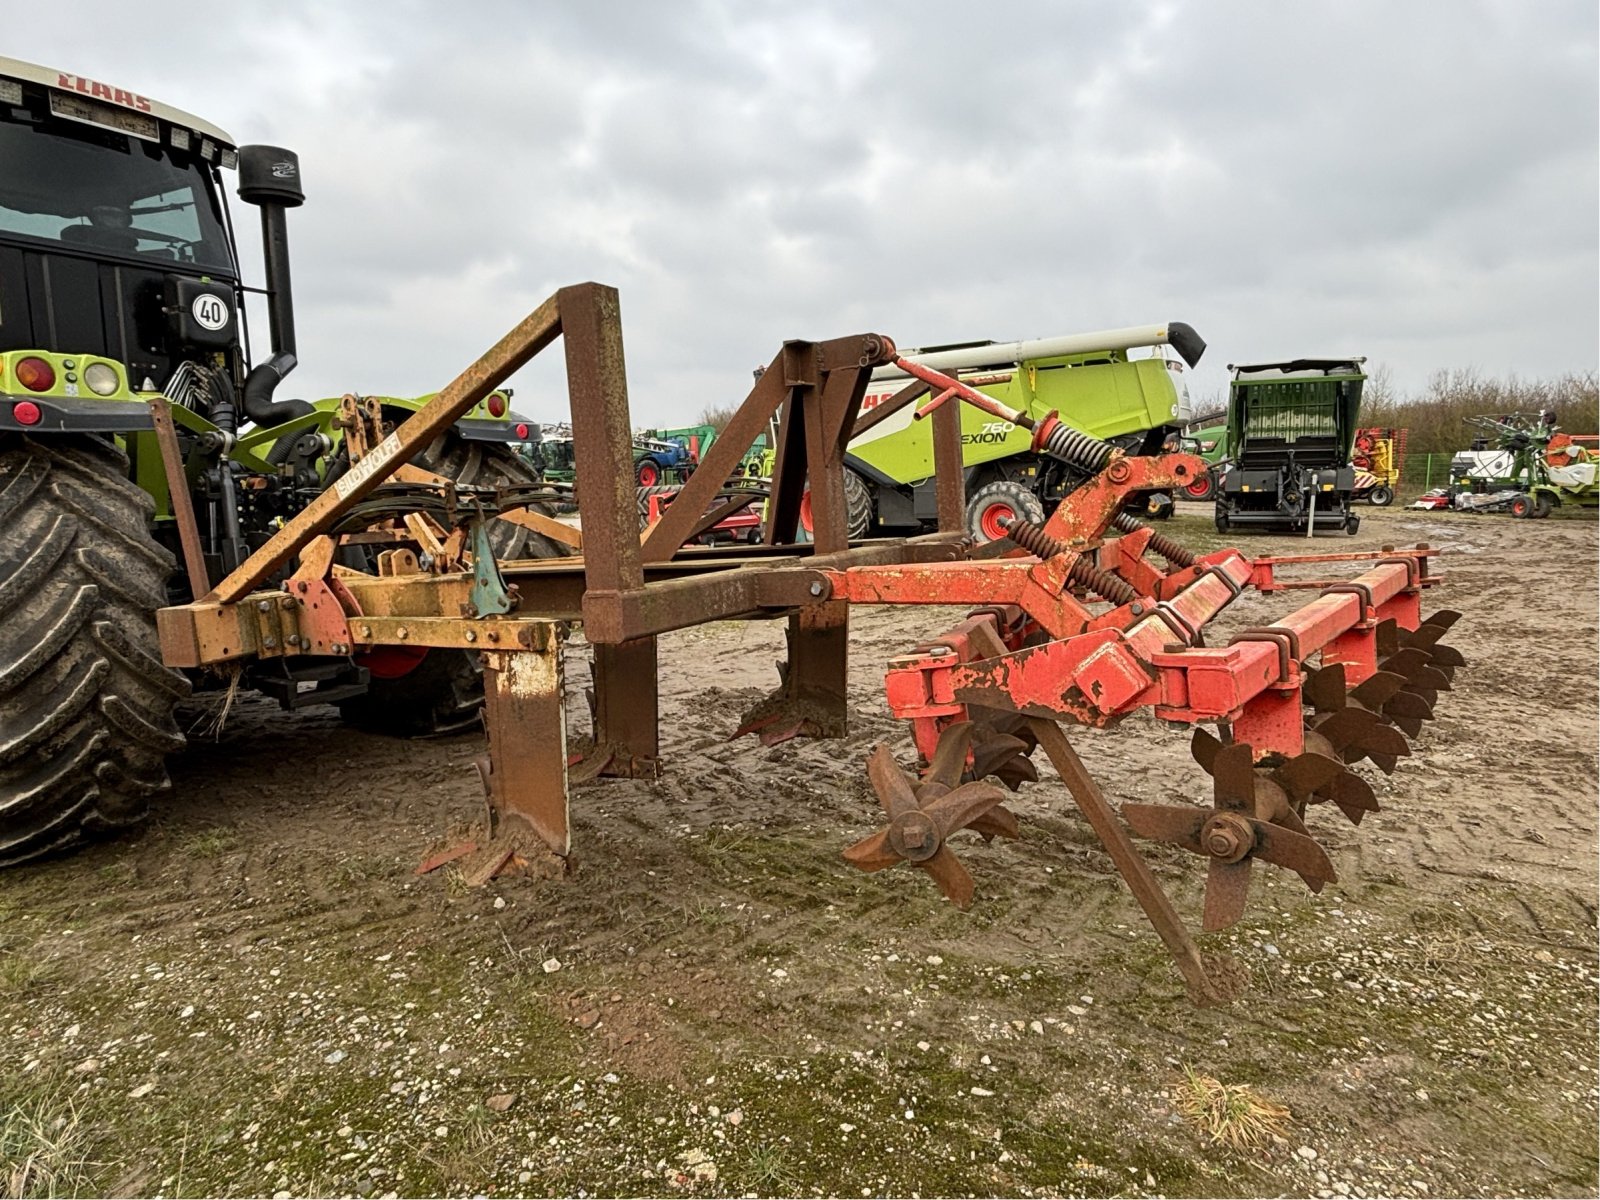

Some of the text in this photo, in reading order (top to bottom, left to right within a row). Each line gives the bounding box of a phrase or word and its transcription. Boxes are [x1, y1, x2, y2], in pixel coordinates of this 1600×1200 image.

[58, 73, 151, 112] CLAAS
[200, 300, 220, 323] 40
[982, 421, 1016, 434] 760
[961, 432, 1007, 444] EXION
